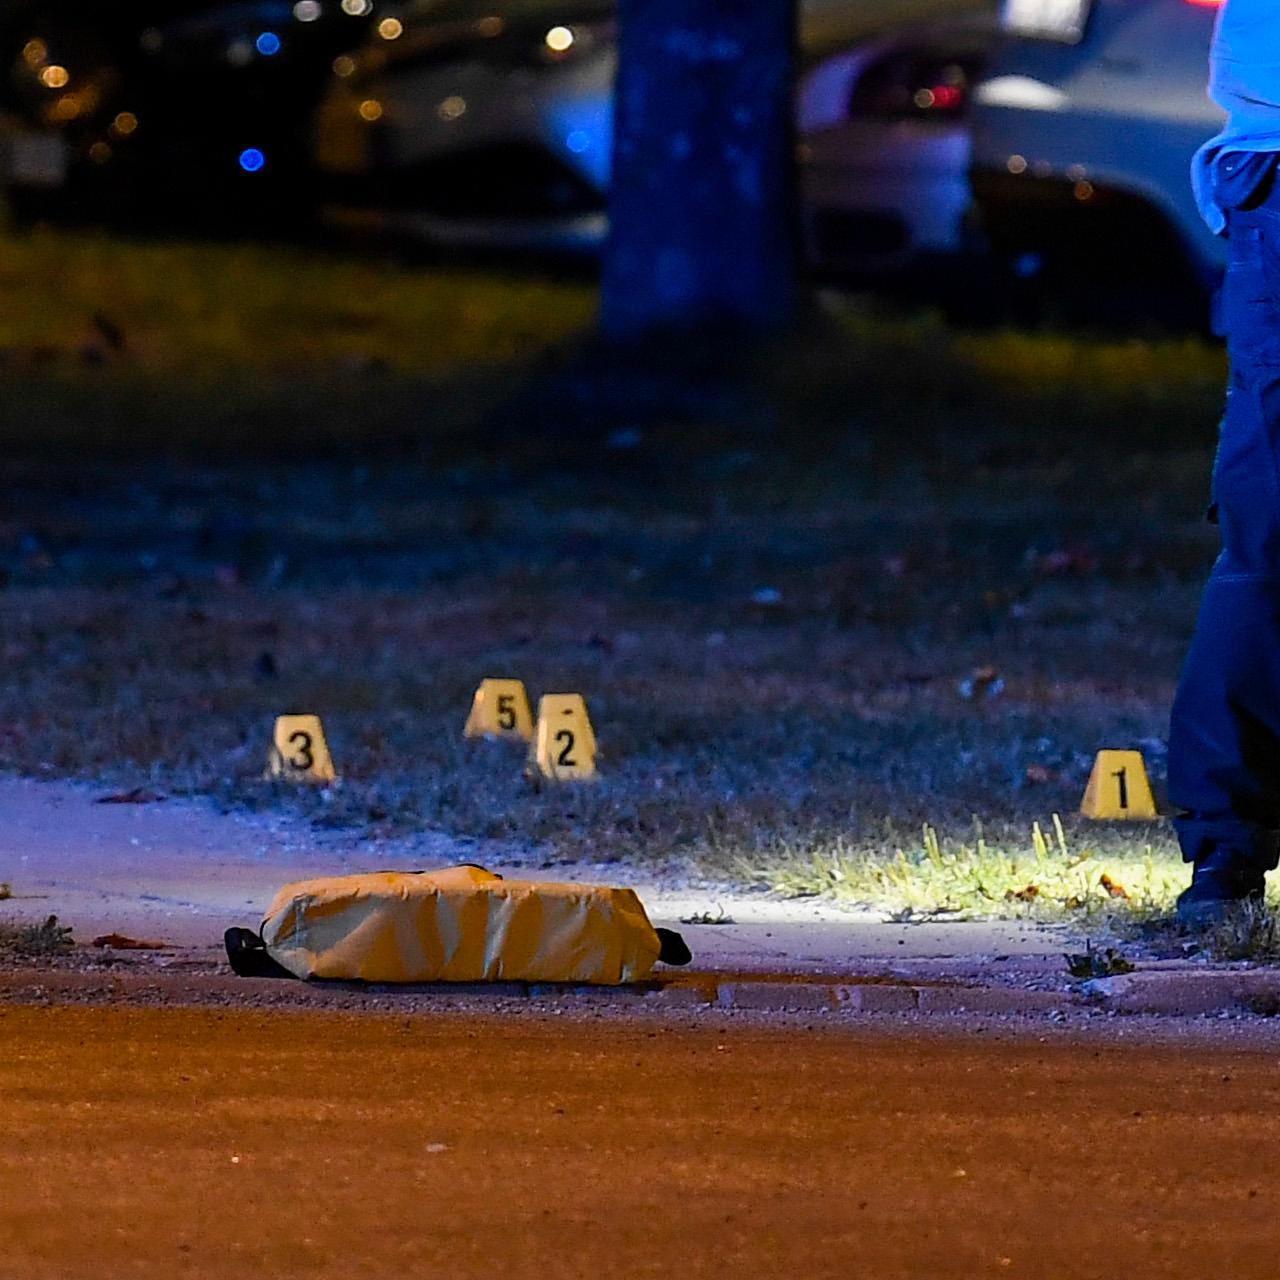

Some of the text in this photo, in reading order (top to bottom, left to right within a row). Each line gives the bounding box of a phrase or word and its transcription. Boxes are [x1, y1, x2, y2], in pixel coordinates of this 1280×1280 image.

[498, 695, 516, 729] 5
[290, 732, 313, 770] 3
[557, 730, 576, 766] 2
[1111, 766, 1128, 809] 1
